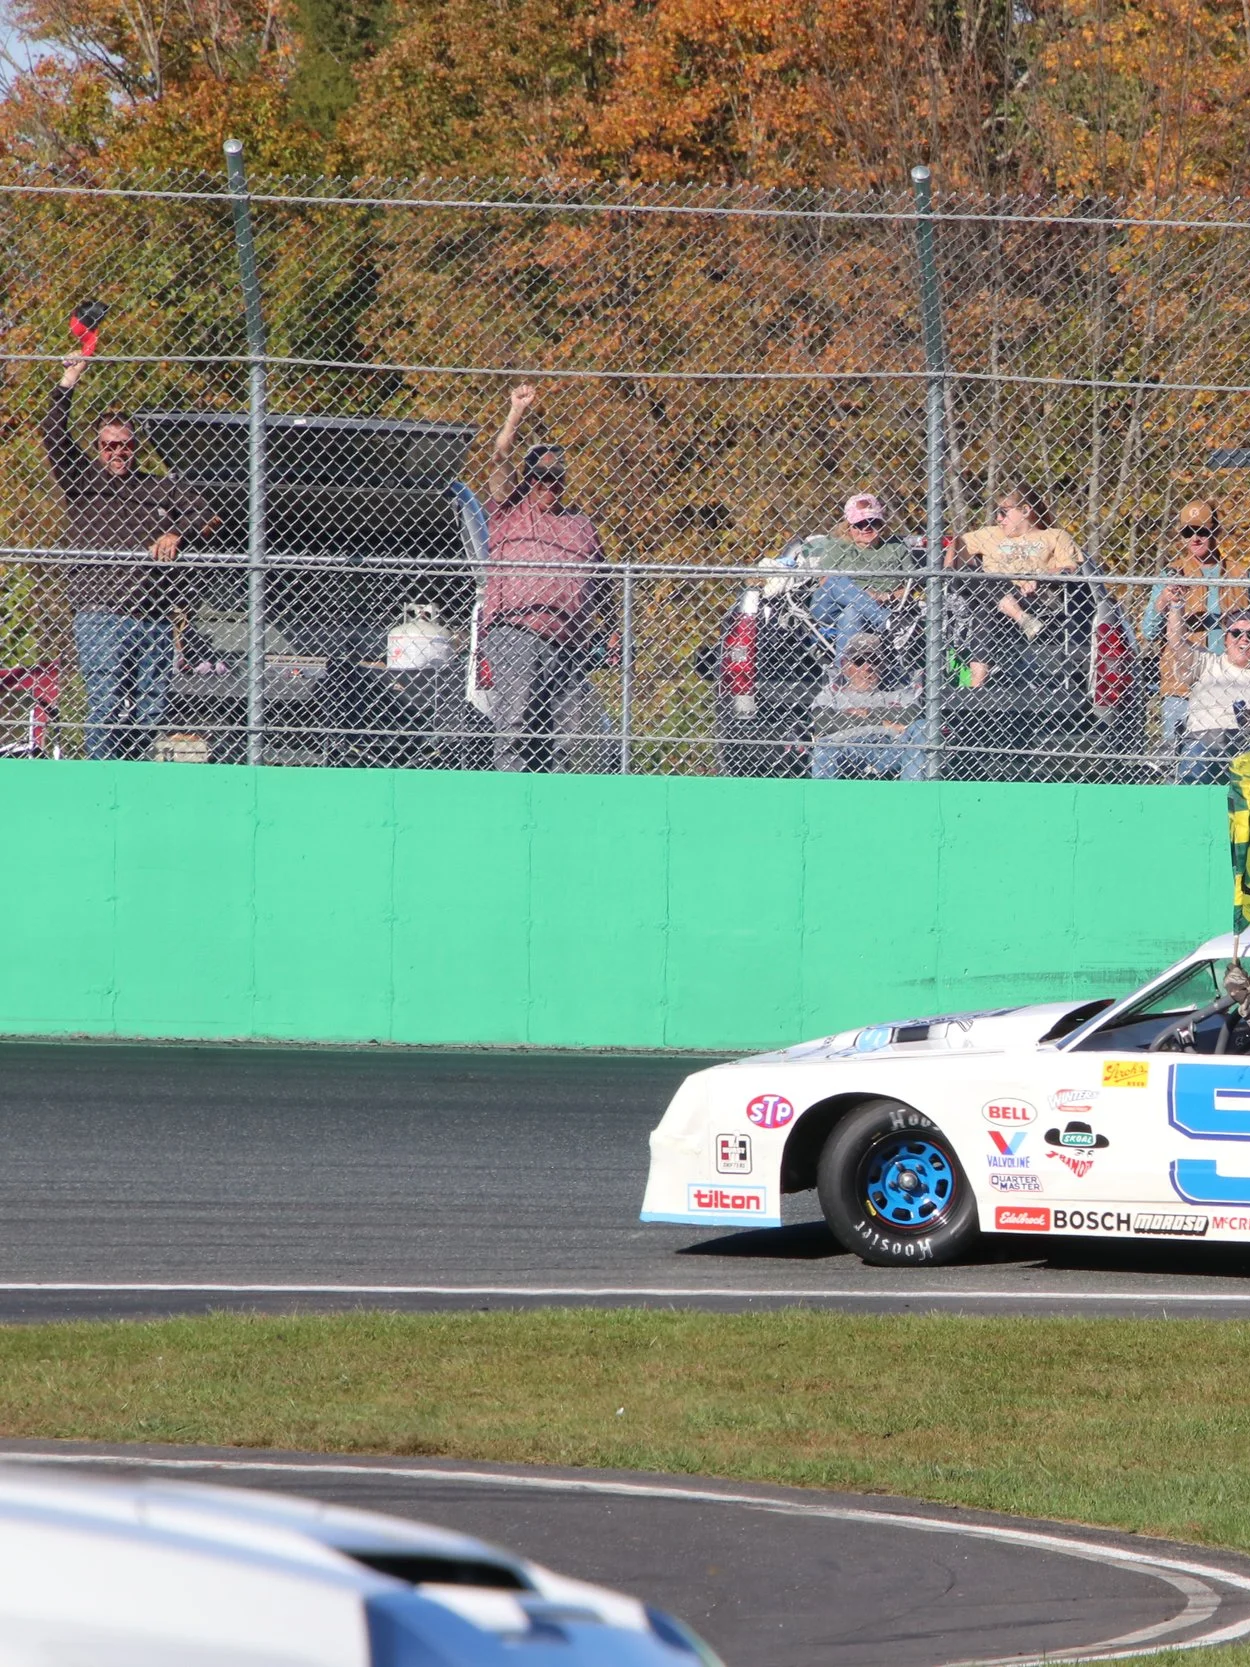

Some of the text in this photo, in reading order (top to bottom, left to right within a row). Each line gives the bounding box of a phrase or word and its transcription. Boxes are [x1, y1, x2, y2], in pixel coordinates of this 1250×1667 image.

[750, 1096, 791, 1124] STP
[988, 1106, 1030, 1120] BELL
[1063, 1133, 1092, 1144] SKOAL
[986, 1155, 1030, 1168] VALVOLINE
[991, 1175, 1037, 1185] QUARTER
[1000, 1182, 1040, 1190] MASTER
[694, 1190, 760, 1210] tilton
[999, 1212, 1046, 1226] Edelbrock
[1054, 1210, 1131, 1231] BOSCH
[1133, 1213, 1209, 1236] MOROSO
